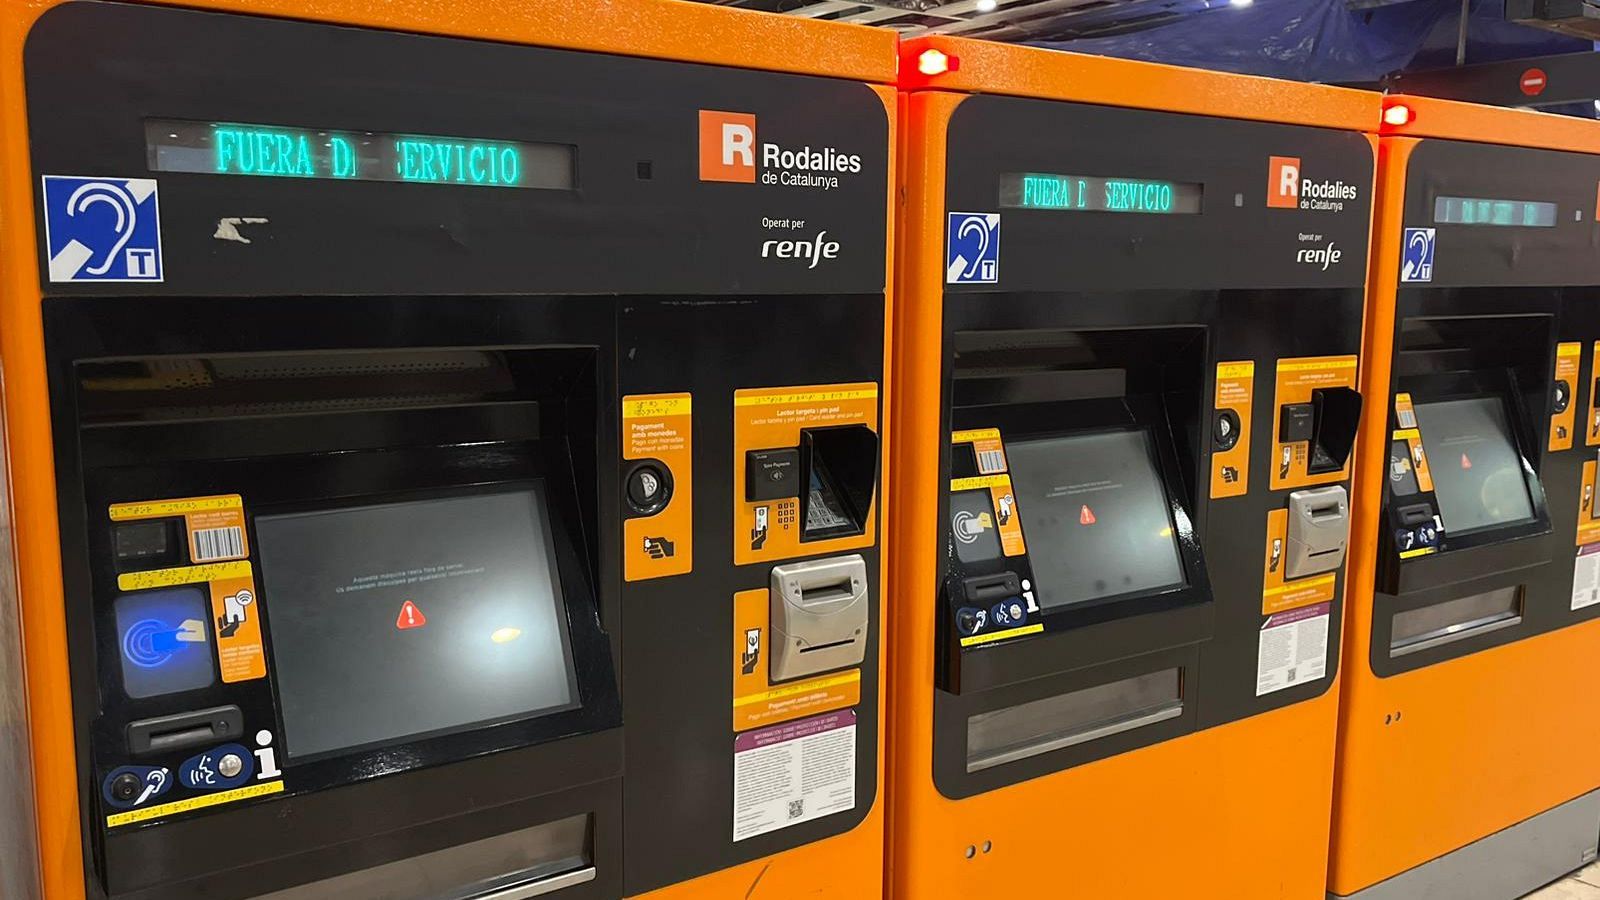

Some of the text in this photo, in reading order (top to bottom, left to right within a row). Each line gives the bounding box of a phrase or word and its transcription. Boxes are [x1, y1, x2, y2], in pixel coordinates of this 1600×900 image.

[213, 130, 314, 175] FUERA
[396, 140, 519, 184] ERVICIO
[722, 122, 754, 166] R
[763, 143, 862, 173] Rodalies
[762, 171, 839, 190] de Catalunya
[1023, 177, 1070, 207] FUERA
[1105, 182, 1170, 211] SERVICIO
[1280, 164, 1299, 197] R
[1301, 179, 1357, 200] Rodalies
[1300, 199, 1344, 213] de Catalunya
[761, 217, 805, 230] Operat per
[129, 251, 152, 275] T
[761, 230, 841, 269] renfe
[1296, 241, 1342, 271] renfe
